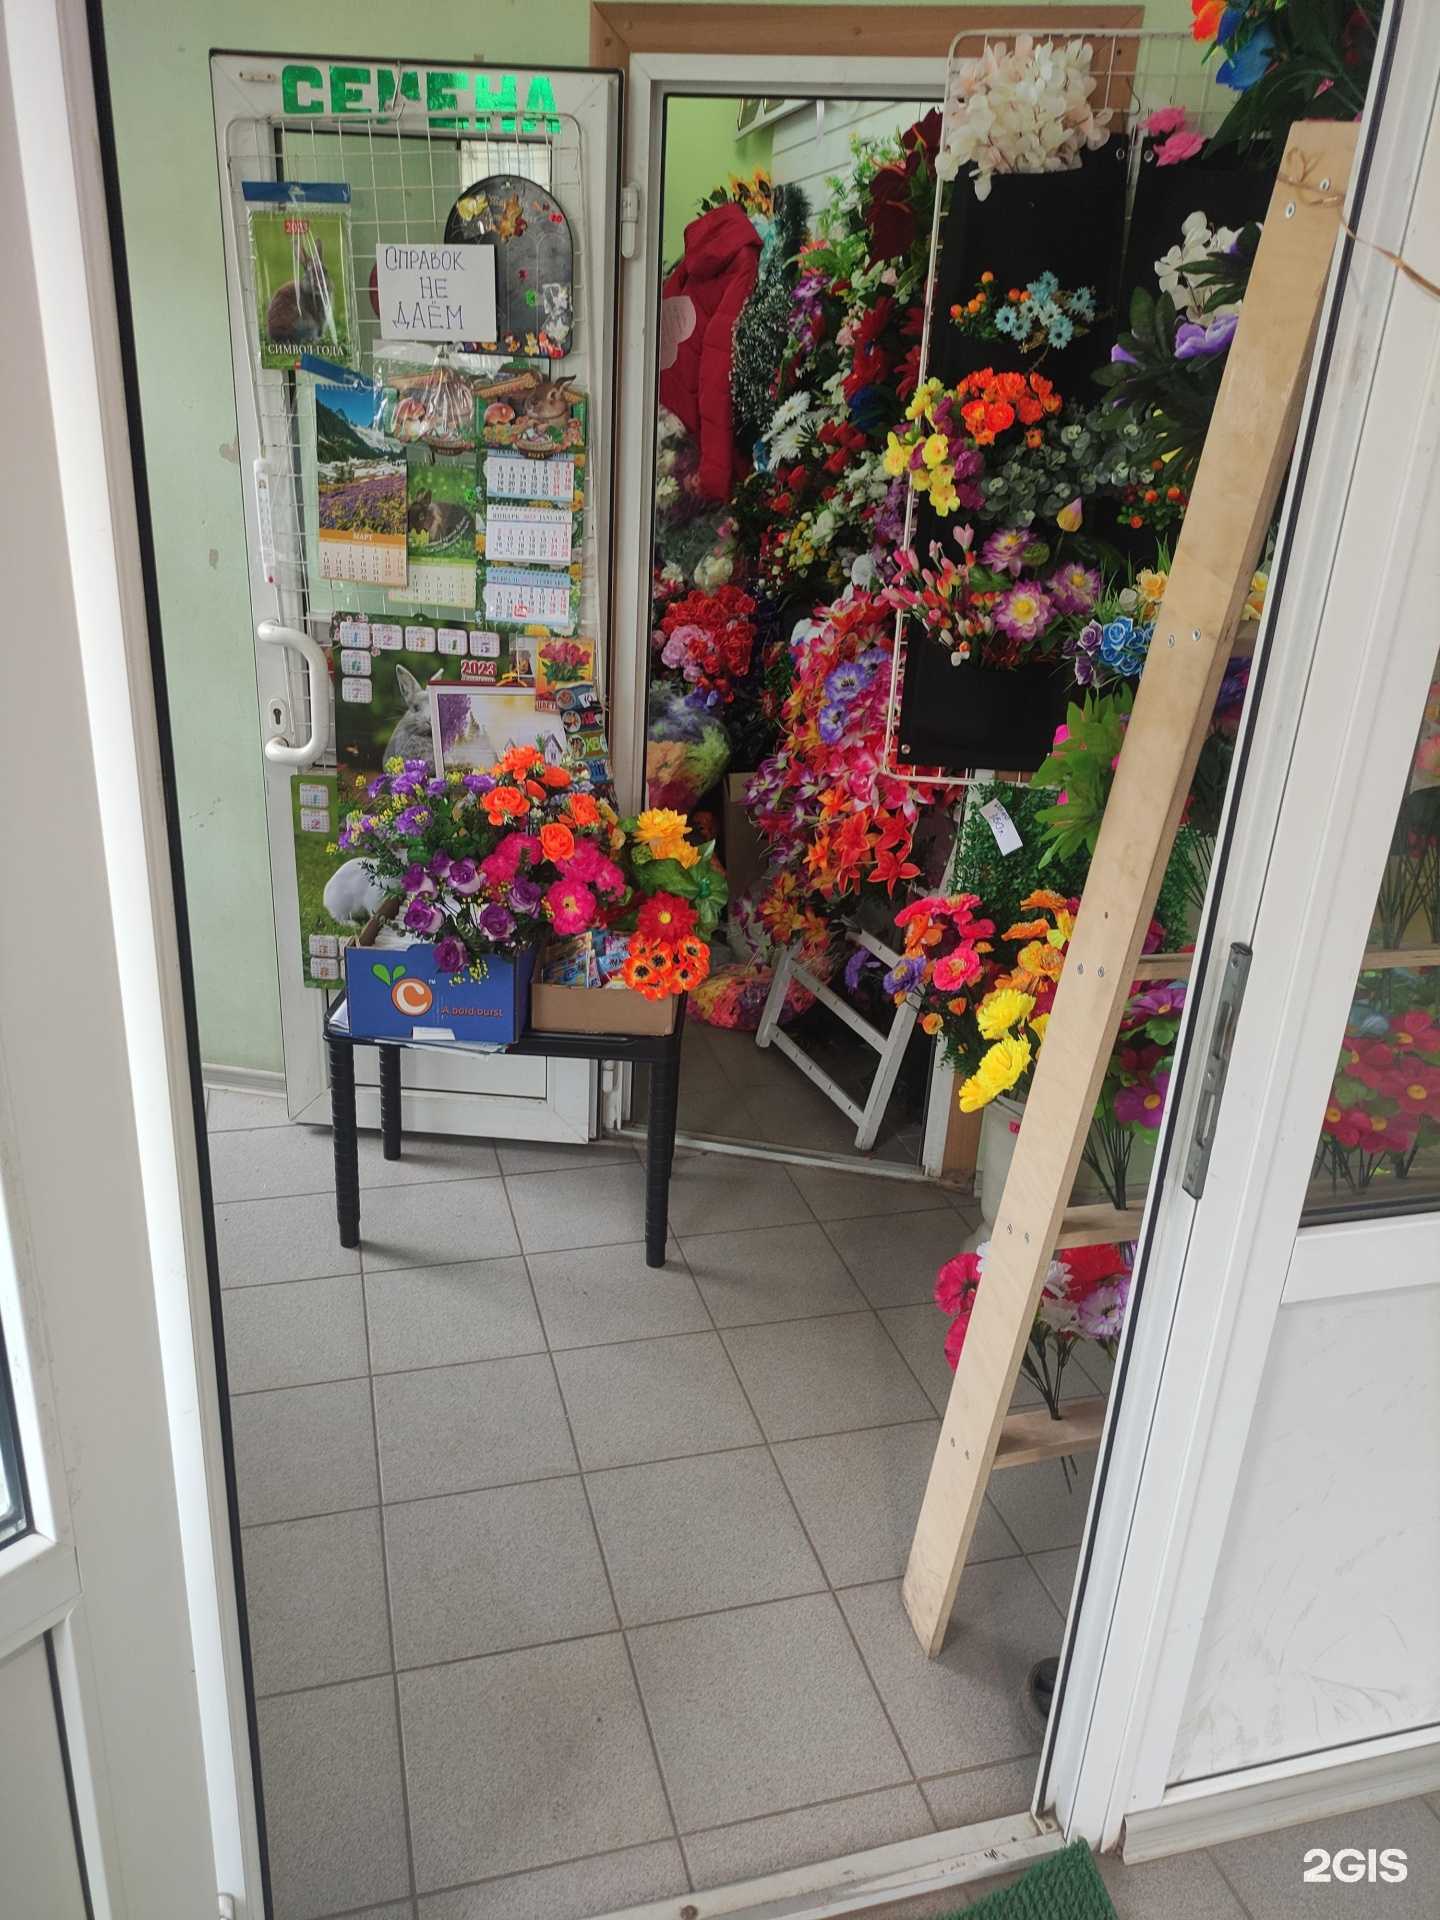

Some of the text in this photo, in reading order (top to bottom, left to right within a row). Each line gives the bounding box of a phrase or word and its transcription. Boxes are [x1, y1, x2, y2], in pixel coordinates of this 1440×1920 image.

[282, 65, 561, 133] СЕМЕНА
[385, 246, 465, 271] СПРАВОК
[420, 276, 448, 299] НЕ
[392, 300, 464, 330] ДАЁМ
[268, 344, 344, 356] СИМВОЛ ГОДА
[461, 660, 497, 675] 2023
